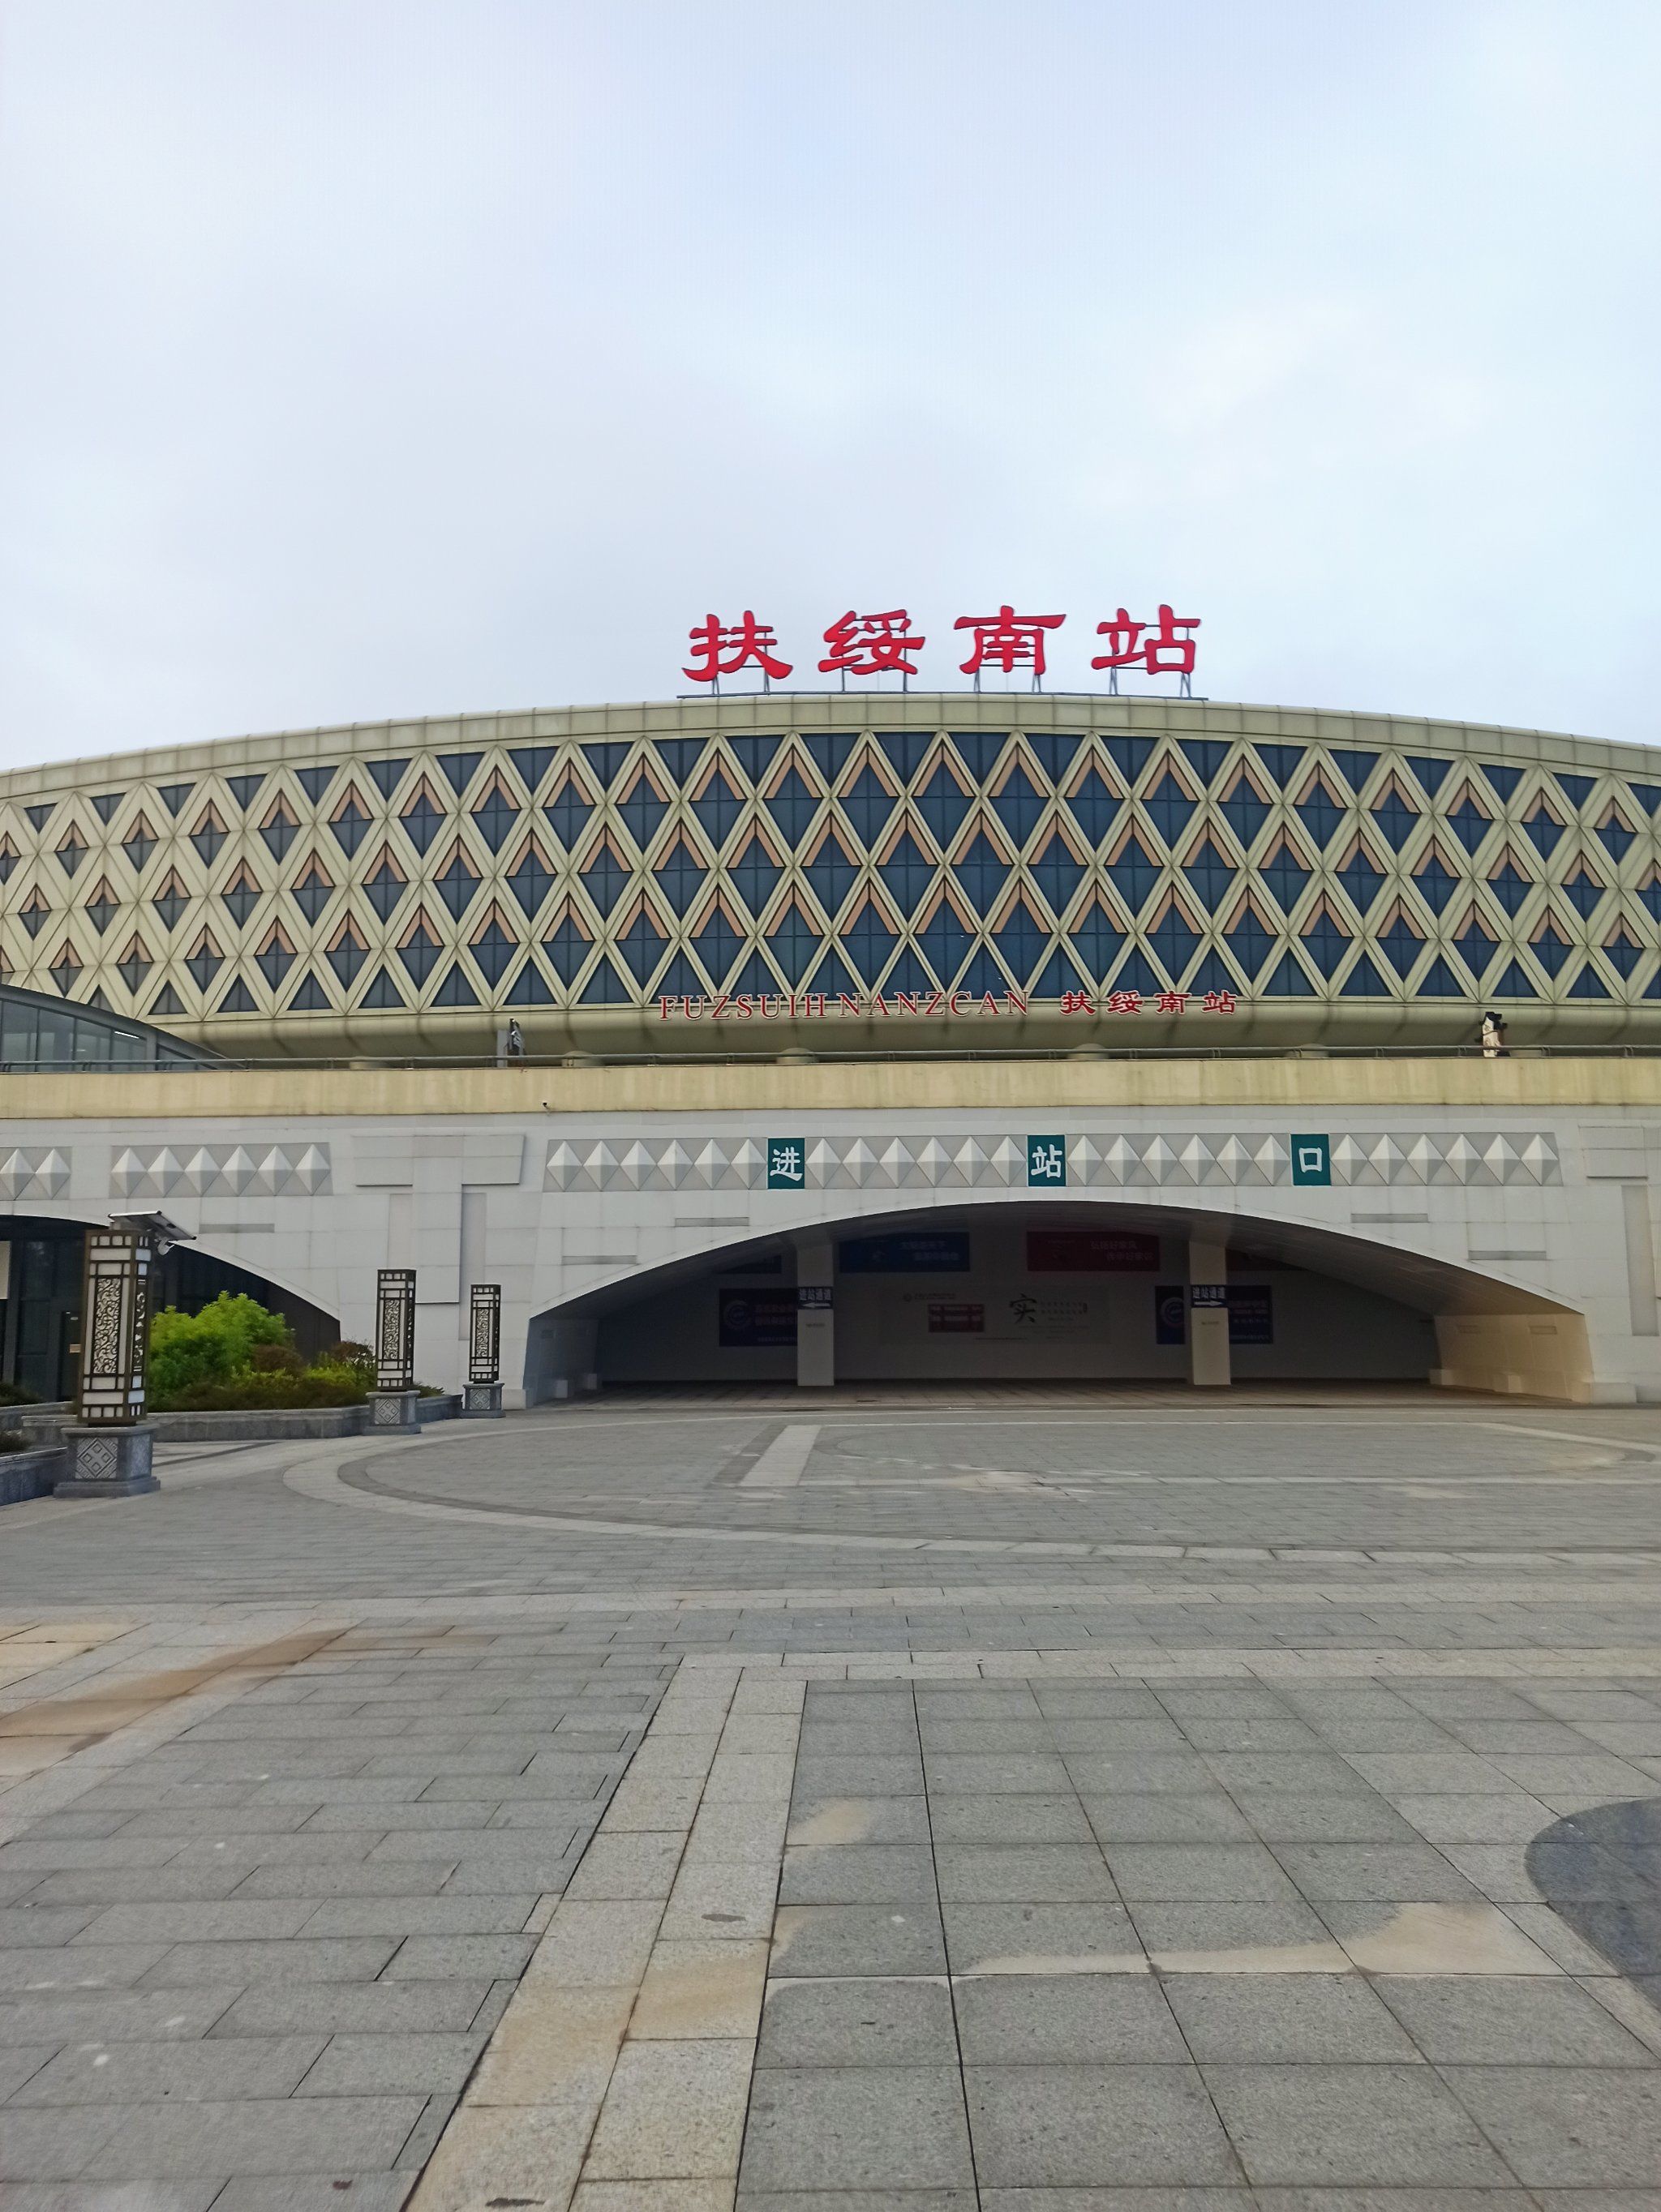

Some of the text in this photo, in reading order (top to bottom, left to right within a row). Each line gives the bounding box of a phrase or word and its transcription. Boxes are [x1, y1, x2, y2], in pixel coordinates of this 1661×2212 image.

[683, 605, 1201, 682] 扶绥南站
[659, 990, 1029, 1020] FUZSUIH NANZCAN
[1060, 989, 1238, 1016] 扶绥南站
[1009, 1293, 1037, 1324] 实
